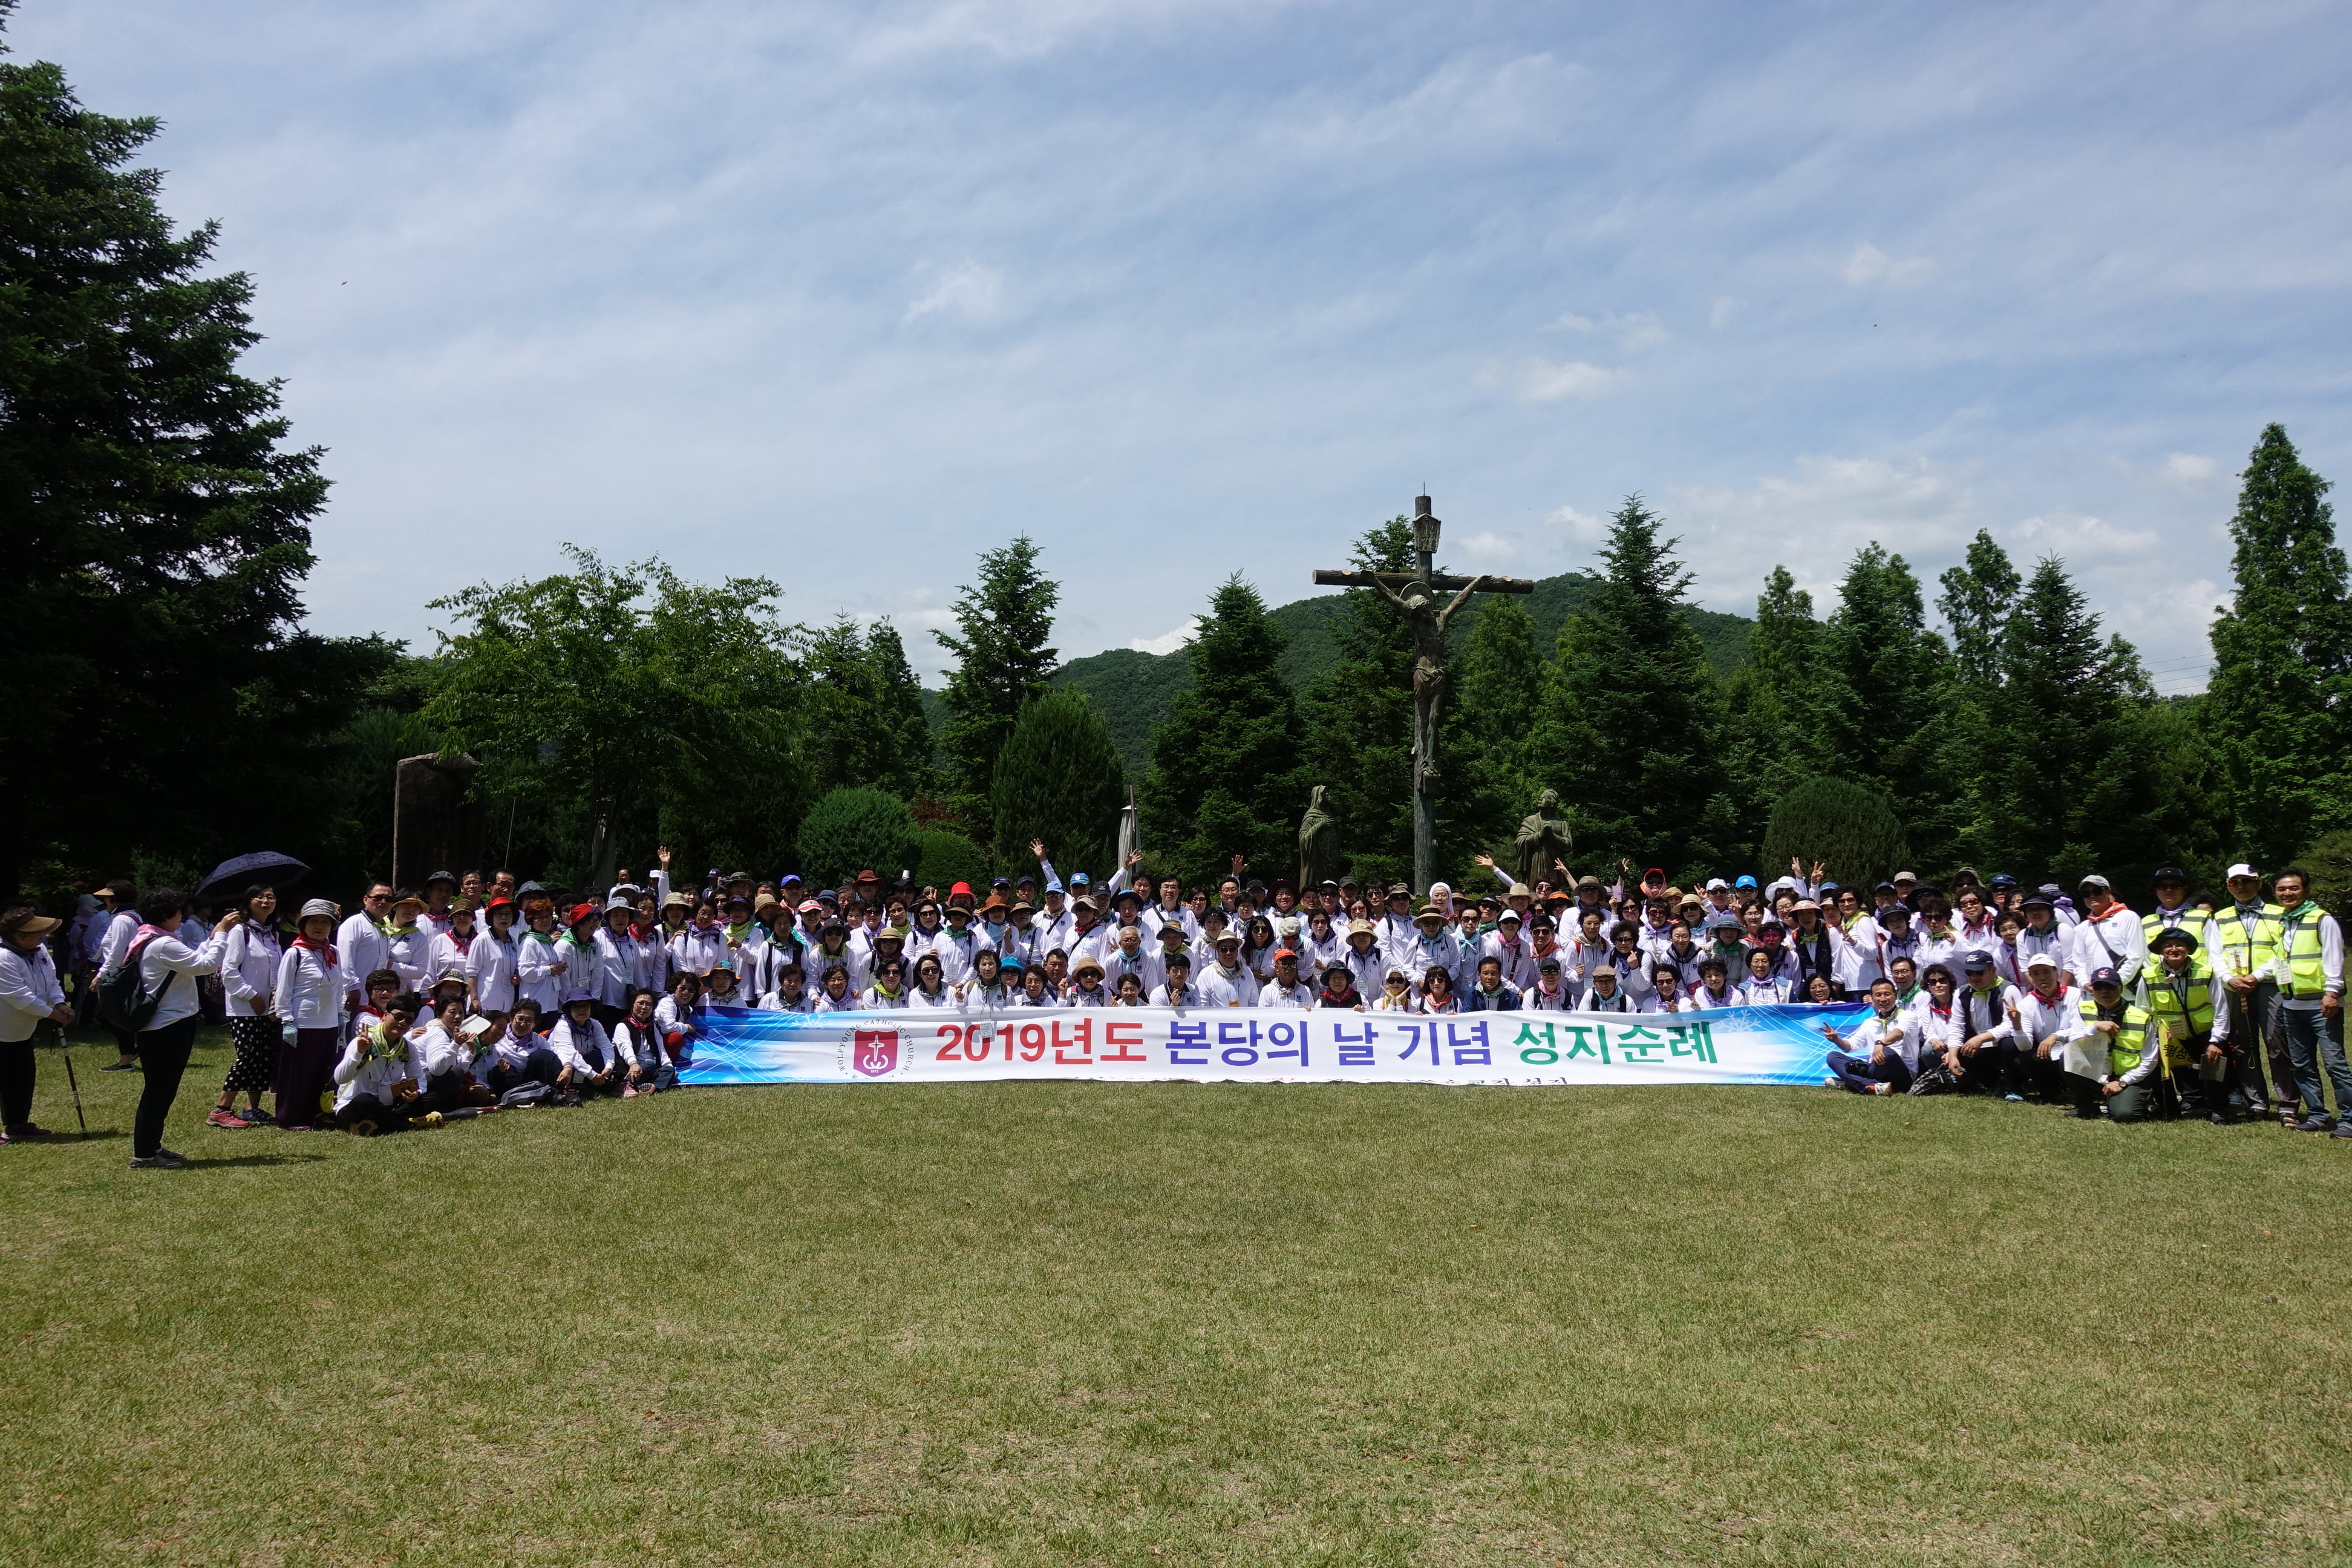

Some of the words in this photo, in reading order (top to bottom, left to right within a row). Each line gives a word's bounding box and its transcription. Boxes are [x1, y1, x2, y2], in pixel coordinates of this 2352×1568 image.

[837, 1024, 861, 1071] WOLPYOUNG
[864, 1019, 906, 1034] CATHOLIC
[904, 1034, 914, 1071] CHURCH
[937, 1018, 1146, 1065] 2019년도
[1166, 1021, 1308, 1067] 본당의
[1334, 1022, 1379, 1066] 날
[1398, 1021, 1491, 1066] 기념
[1513, 1021, 1717, 1065] 성지순례
